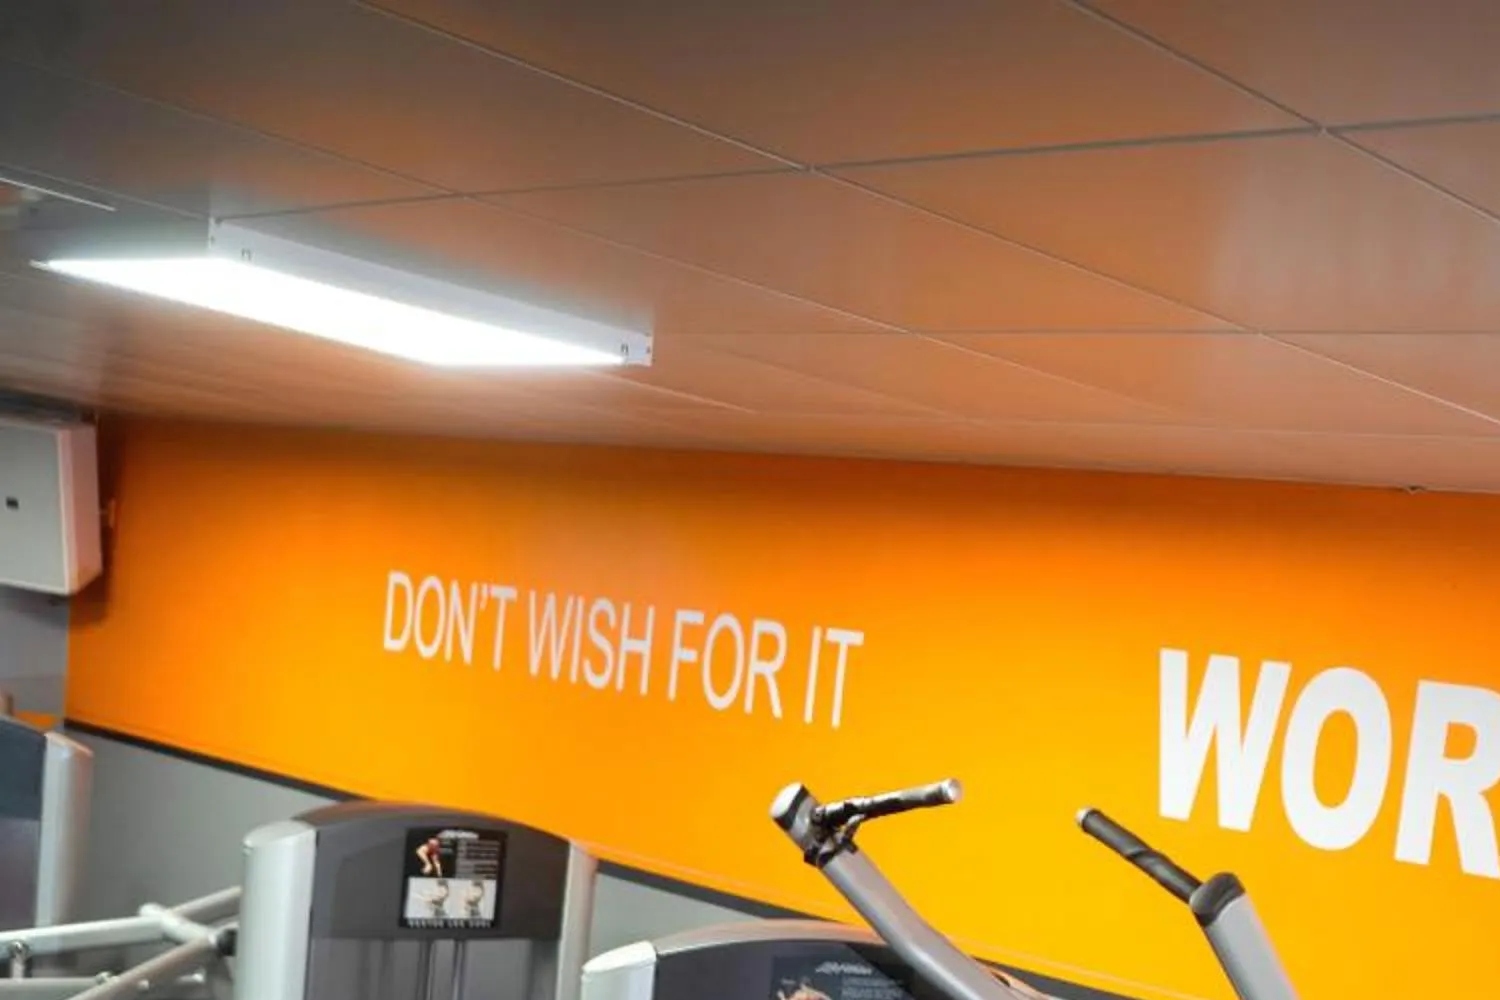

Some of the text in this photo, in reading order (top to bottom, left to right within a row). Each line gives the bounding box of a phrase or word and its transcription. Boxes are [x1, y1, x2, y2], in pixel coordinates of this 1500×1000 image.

[382, 570, 866, 729] DON'T WISH FOR IT
